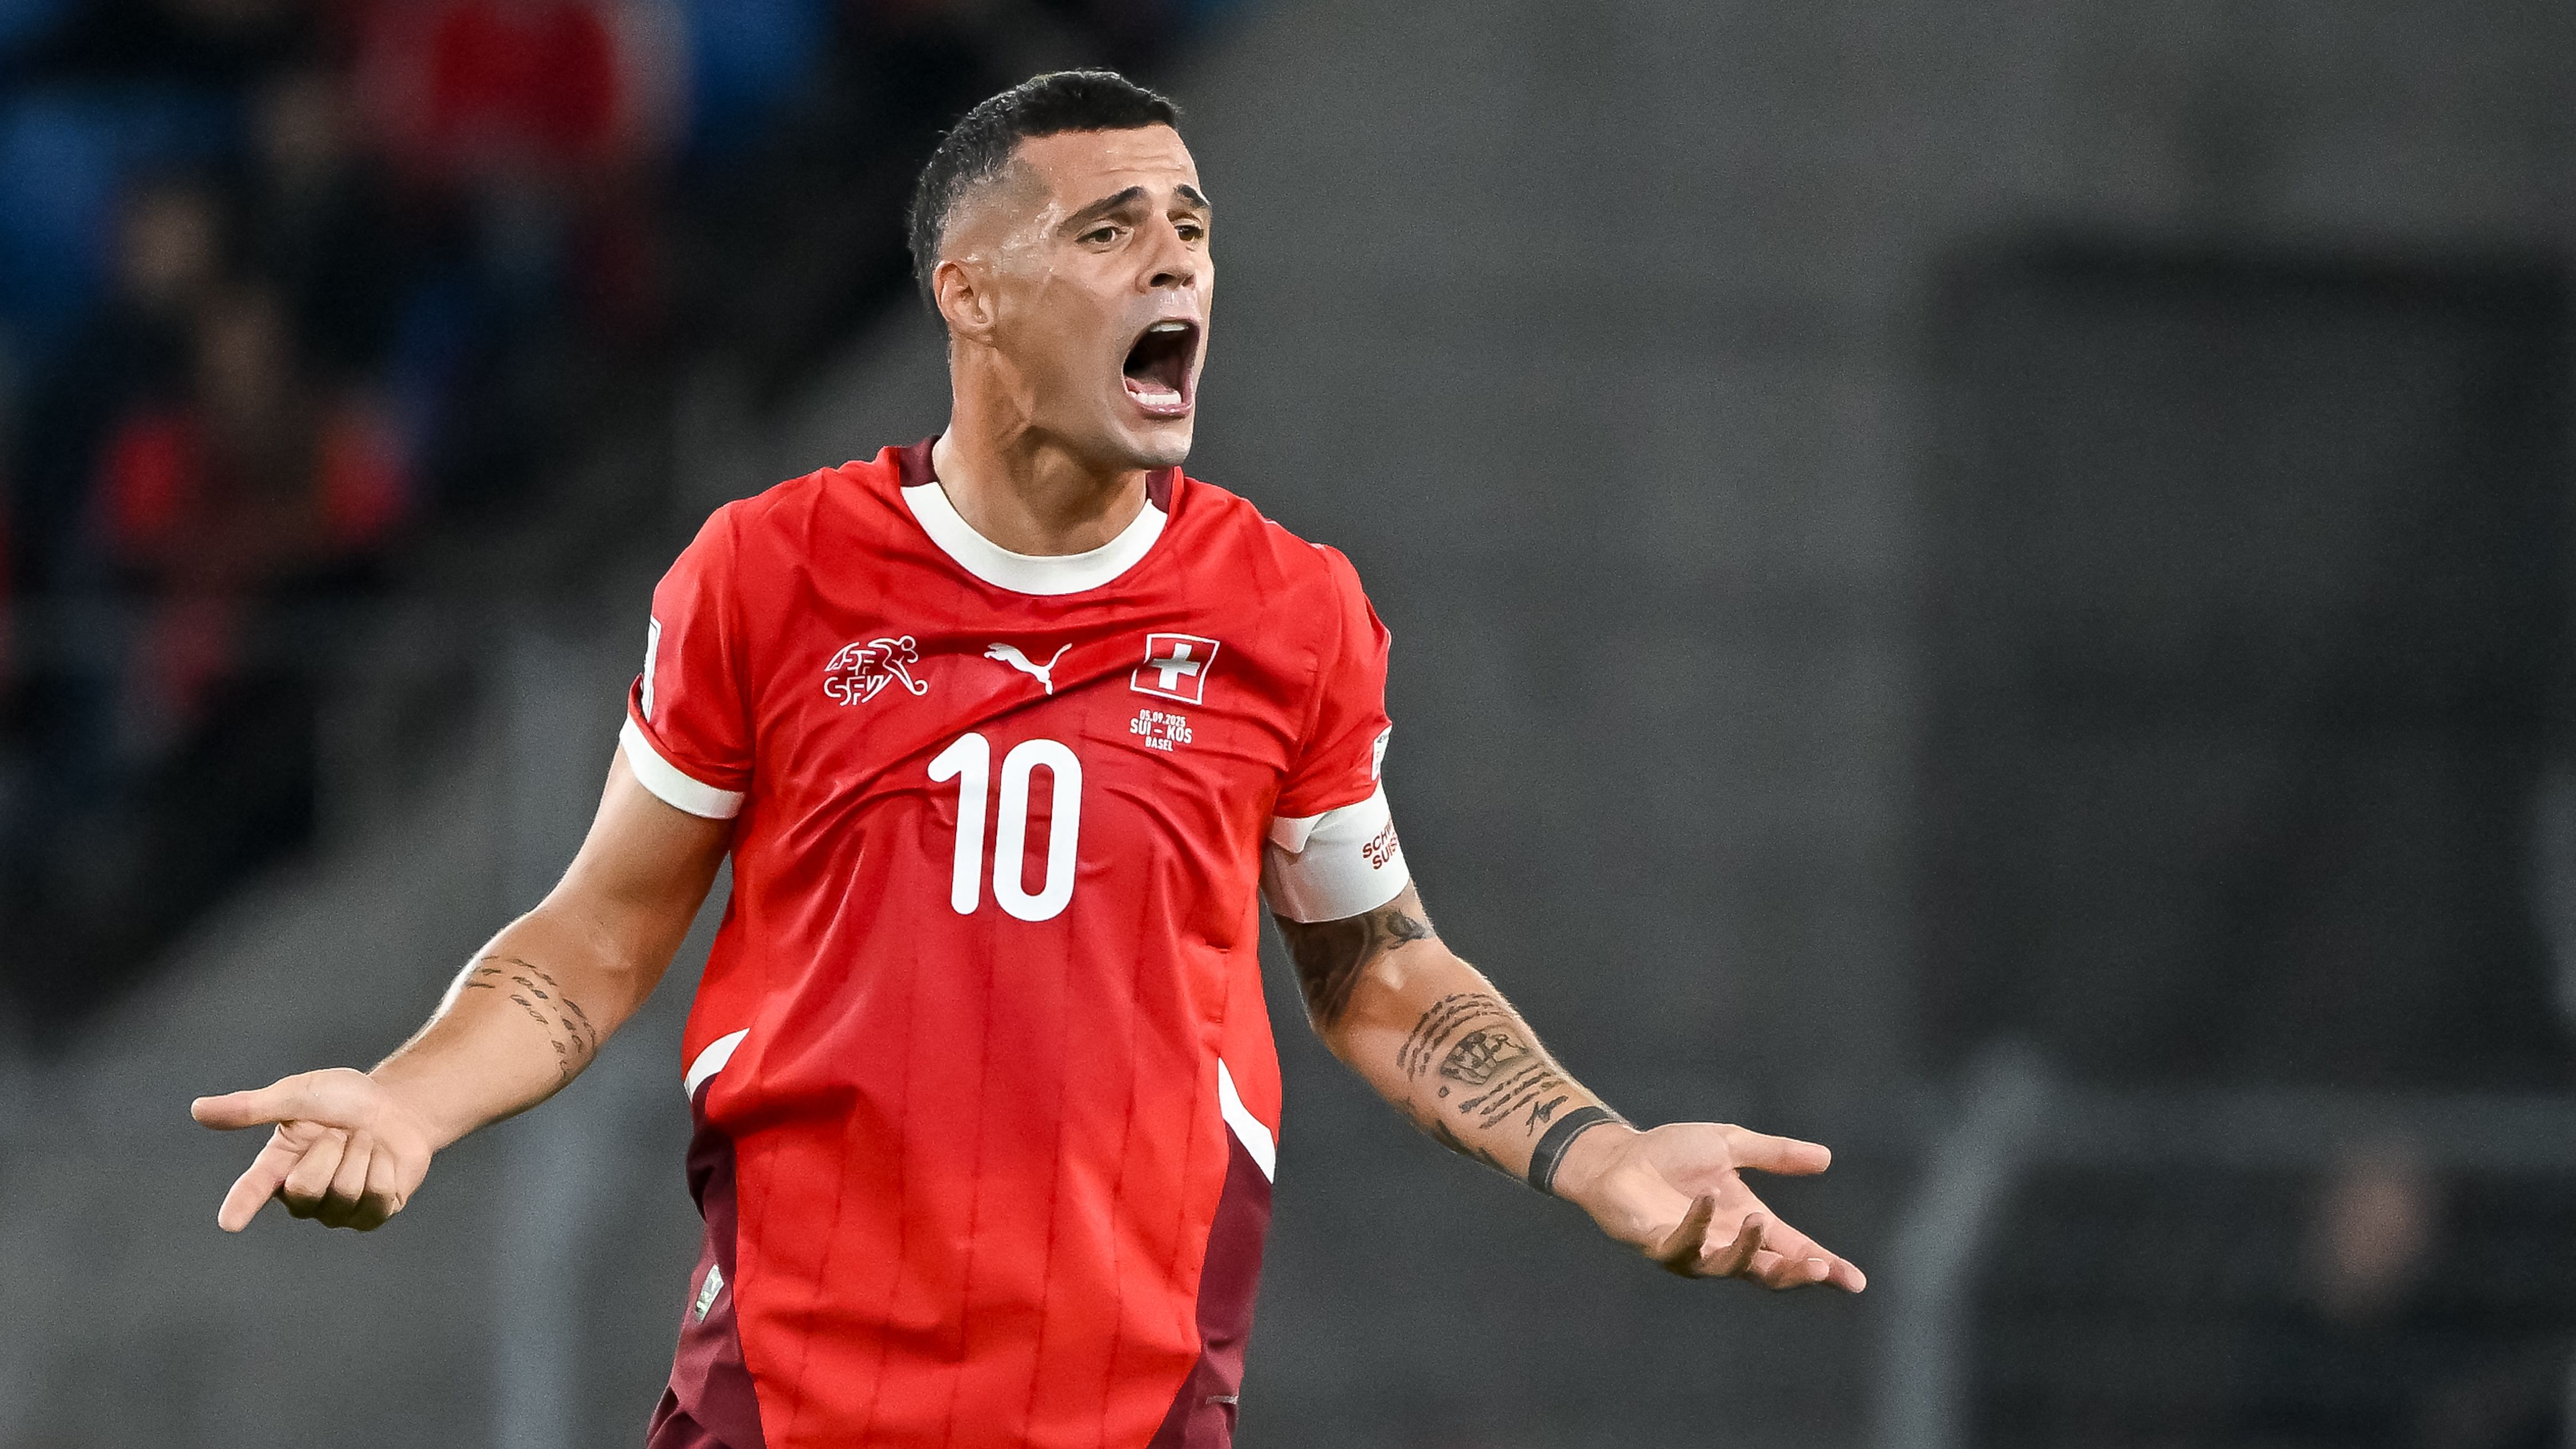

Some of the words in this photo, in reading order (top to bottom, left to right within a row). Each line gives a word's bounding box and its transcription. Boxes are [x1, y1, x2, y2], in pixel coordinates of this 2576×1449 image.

[1139, 709, 1186, 728] 05.09.2025
[1129, 718, 1152, 736] SUI
[1167, 725, 1192, 744] KOS
[1145, 736, 1174, 752] BASEL
[927, 732, 1083, 922] 10
